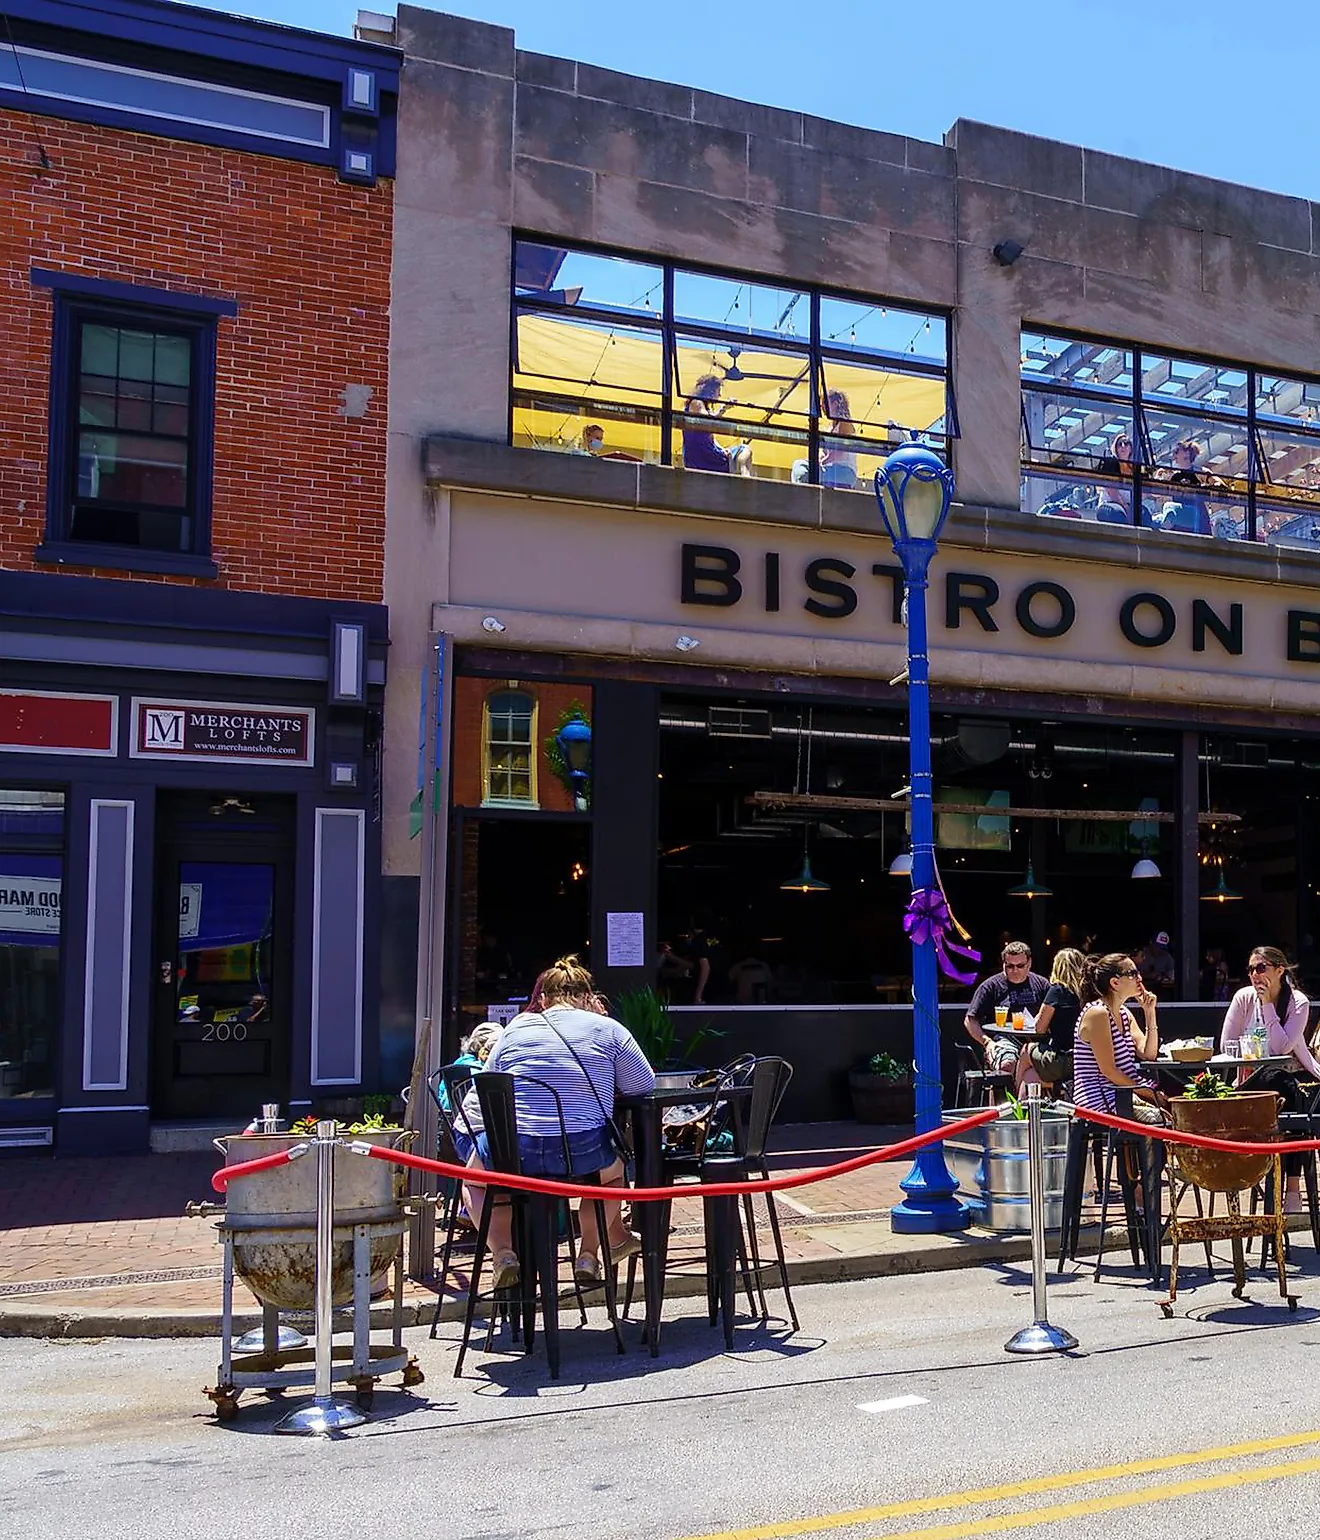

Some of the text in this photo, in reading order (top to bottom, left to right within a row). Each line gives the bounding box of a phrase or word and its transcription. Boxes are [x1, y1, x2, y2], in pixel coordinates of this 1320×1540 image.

[682, 543, 1076, 638] BISTRO
[1119, 592, 1243, 655] ON
[148, 713, 183, 743] M
[190, 714, 301, 732] MERCHANTS
[210, 728, 281, 742] LOFTS
[194, 742, 296, 755] www.merchantslofts.com
[201, 1023, 248, 1042] 200
